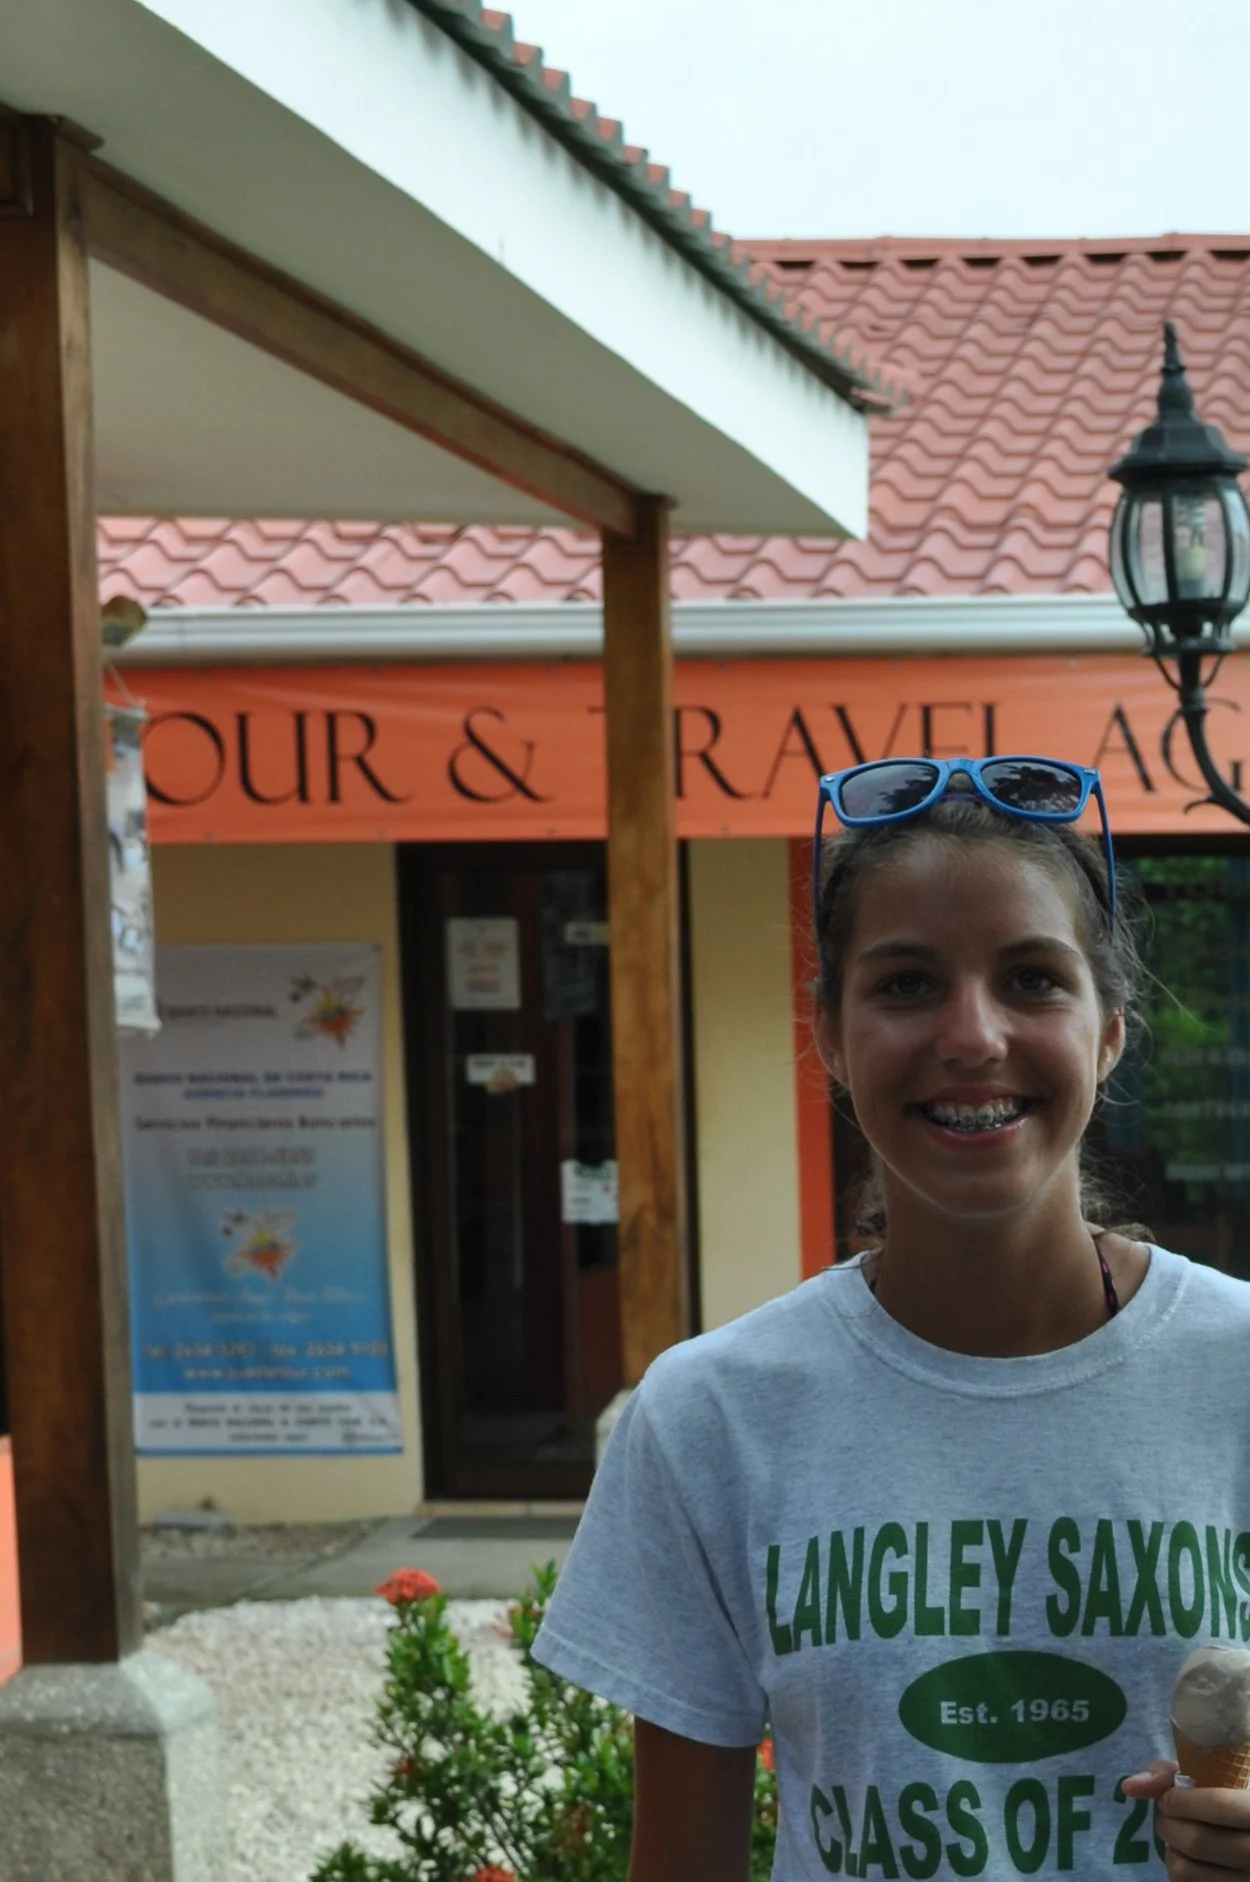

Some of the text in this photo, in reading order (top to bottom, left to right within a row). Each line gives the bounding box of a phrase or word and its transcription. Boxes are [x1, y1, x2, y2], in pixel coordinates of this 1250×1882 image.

[142, 708, 412, 807] OUR
[447, 705, 557, 804] &
[586, 702, 996, 800] RAVEL
[766, 1518, 1028, 1656] LANGLEY
[940, 1699, 1091, 1725] Est. 1965
[810, 1781, 990, 1880] CLASS
[1003, 1776, 1096, 1875] OF
